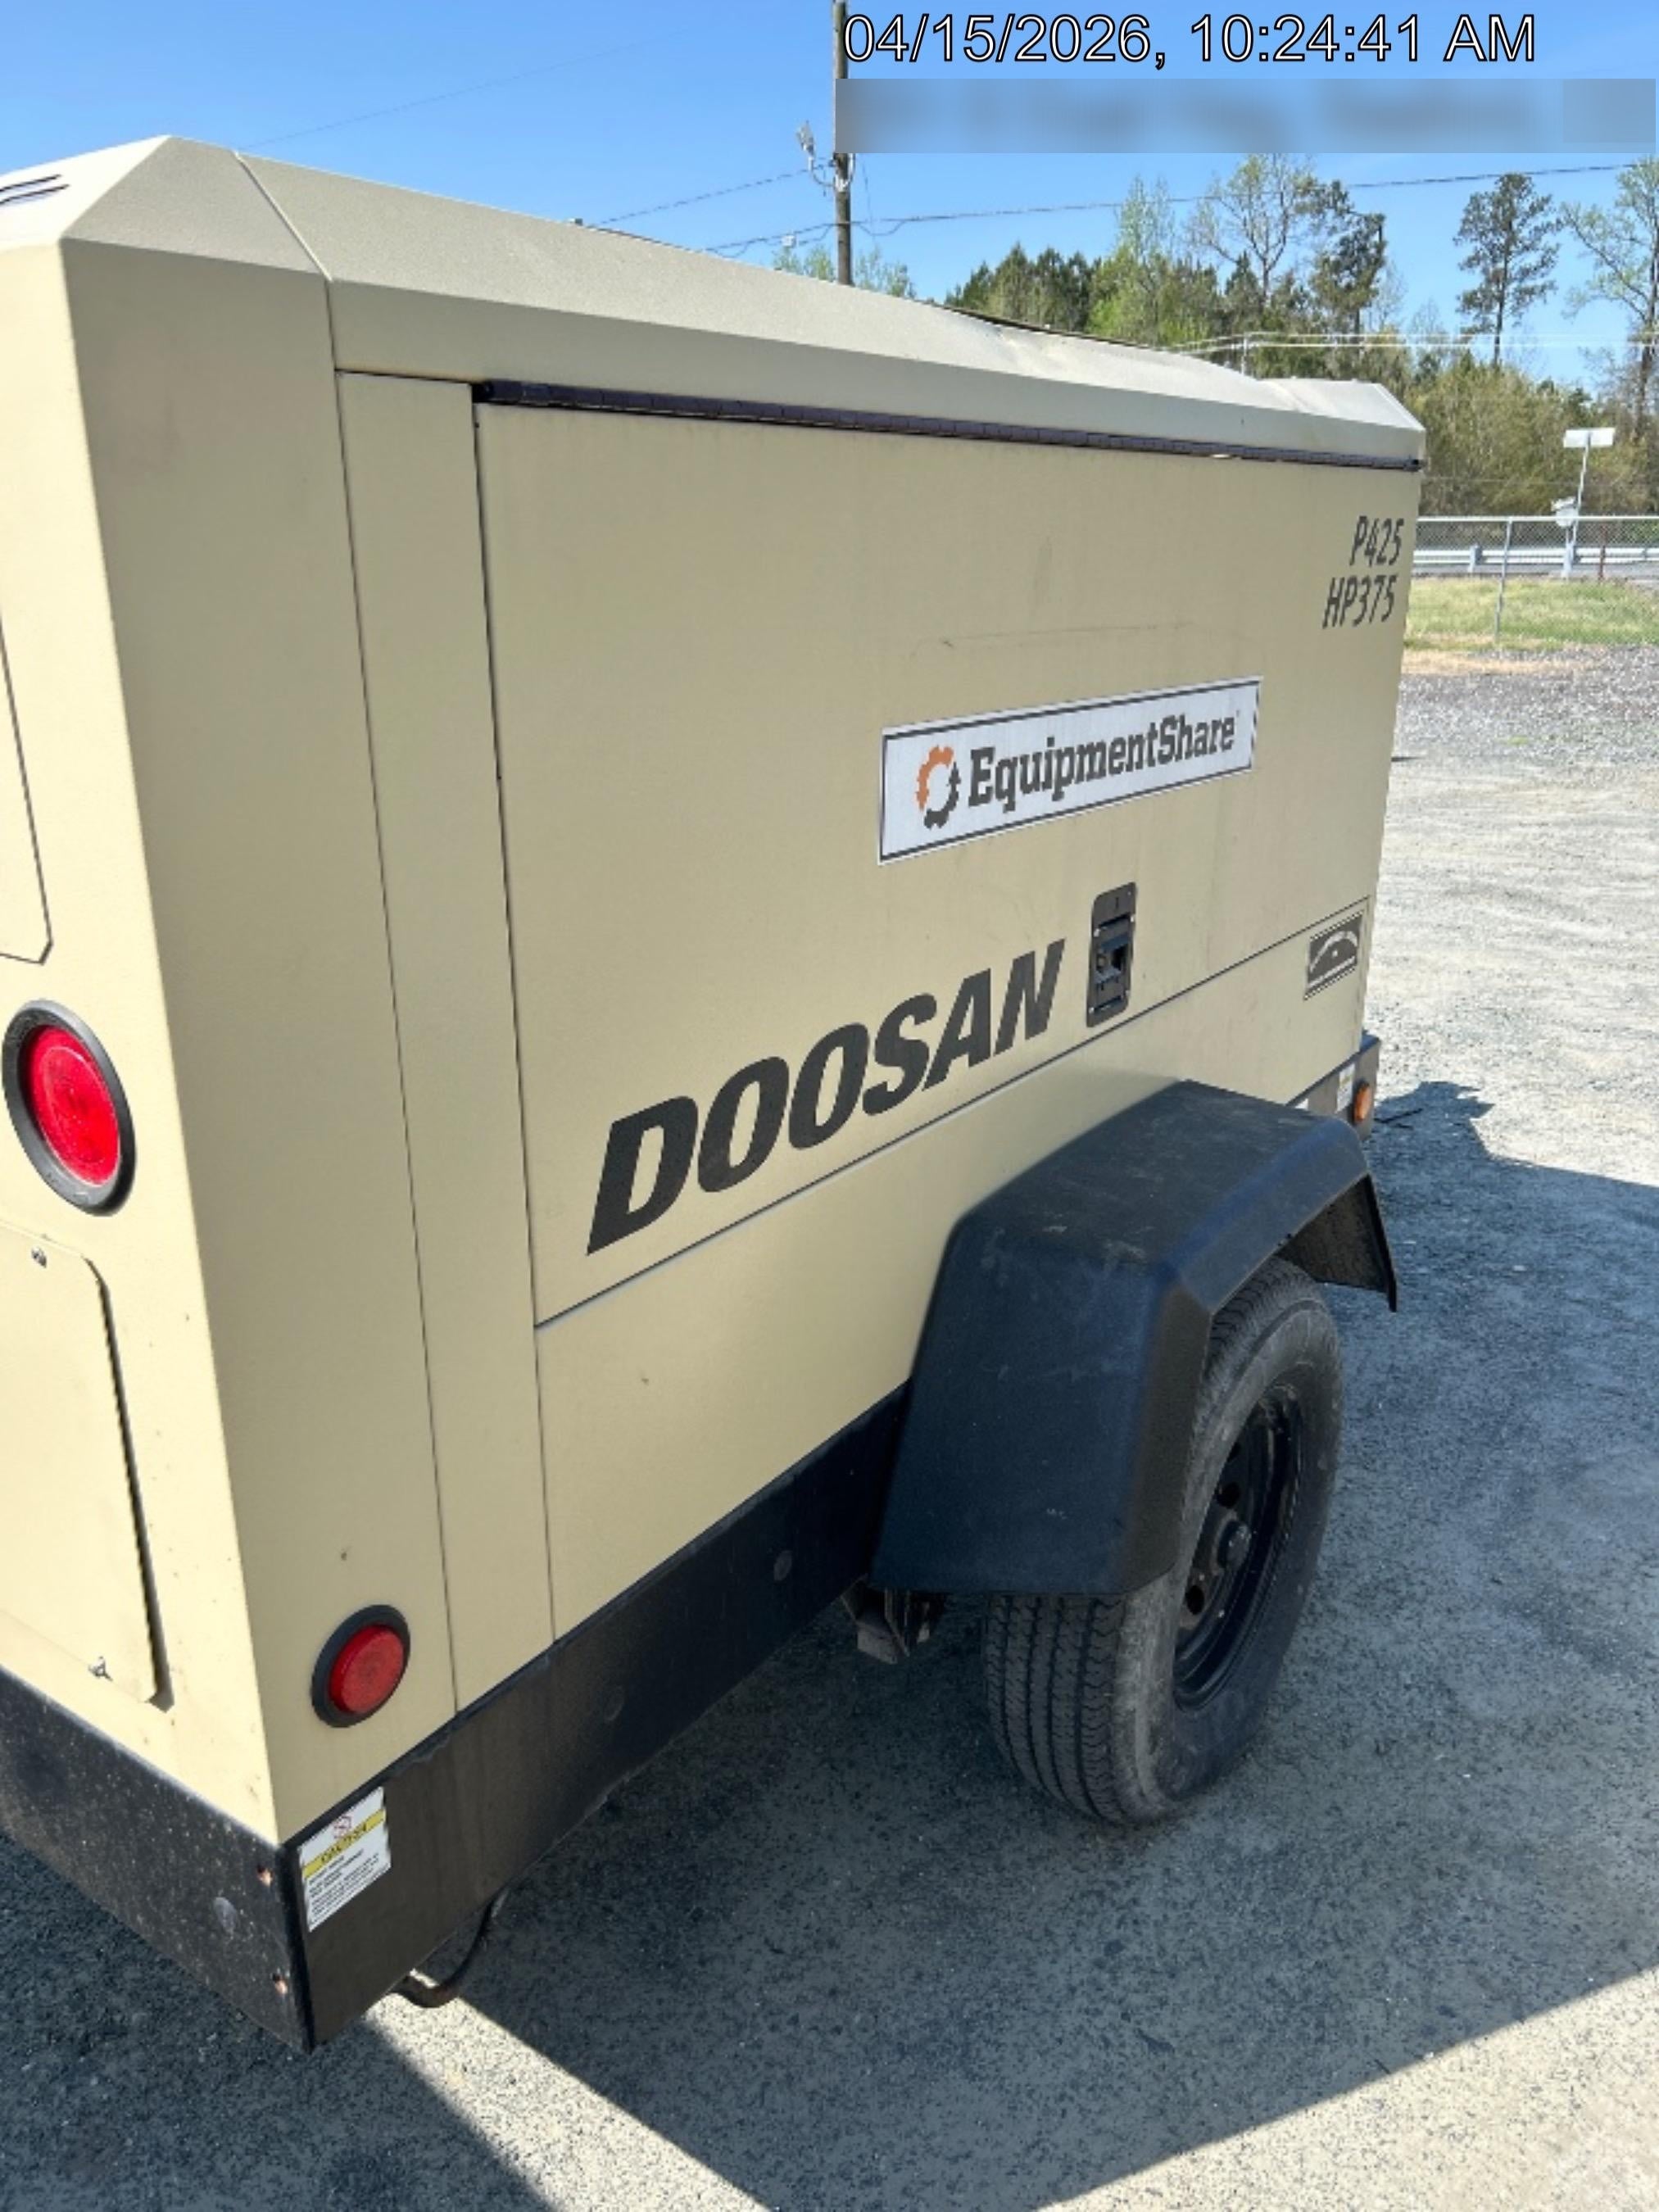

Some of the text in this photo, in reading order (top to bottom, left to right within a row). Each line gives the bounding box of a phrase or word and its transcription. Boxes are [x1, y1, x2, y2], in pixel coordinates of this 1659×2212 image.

[1349, 515, 1404, 567] P425
[1322, 575, 1398, 629] HP375
[968, 714, 1235, 814] EquipmentShare
[587, 938, 1067, 1256] DOOSAN
